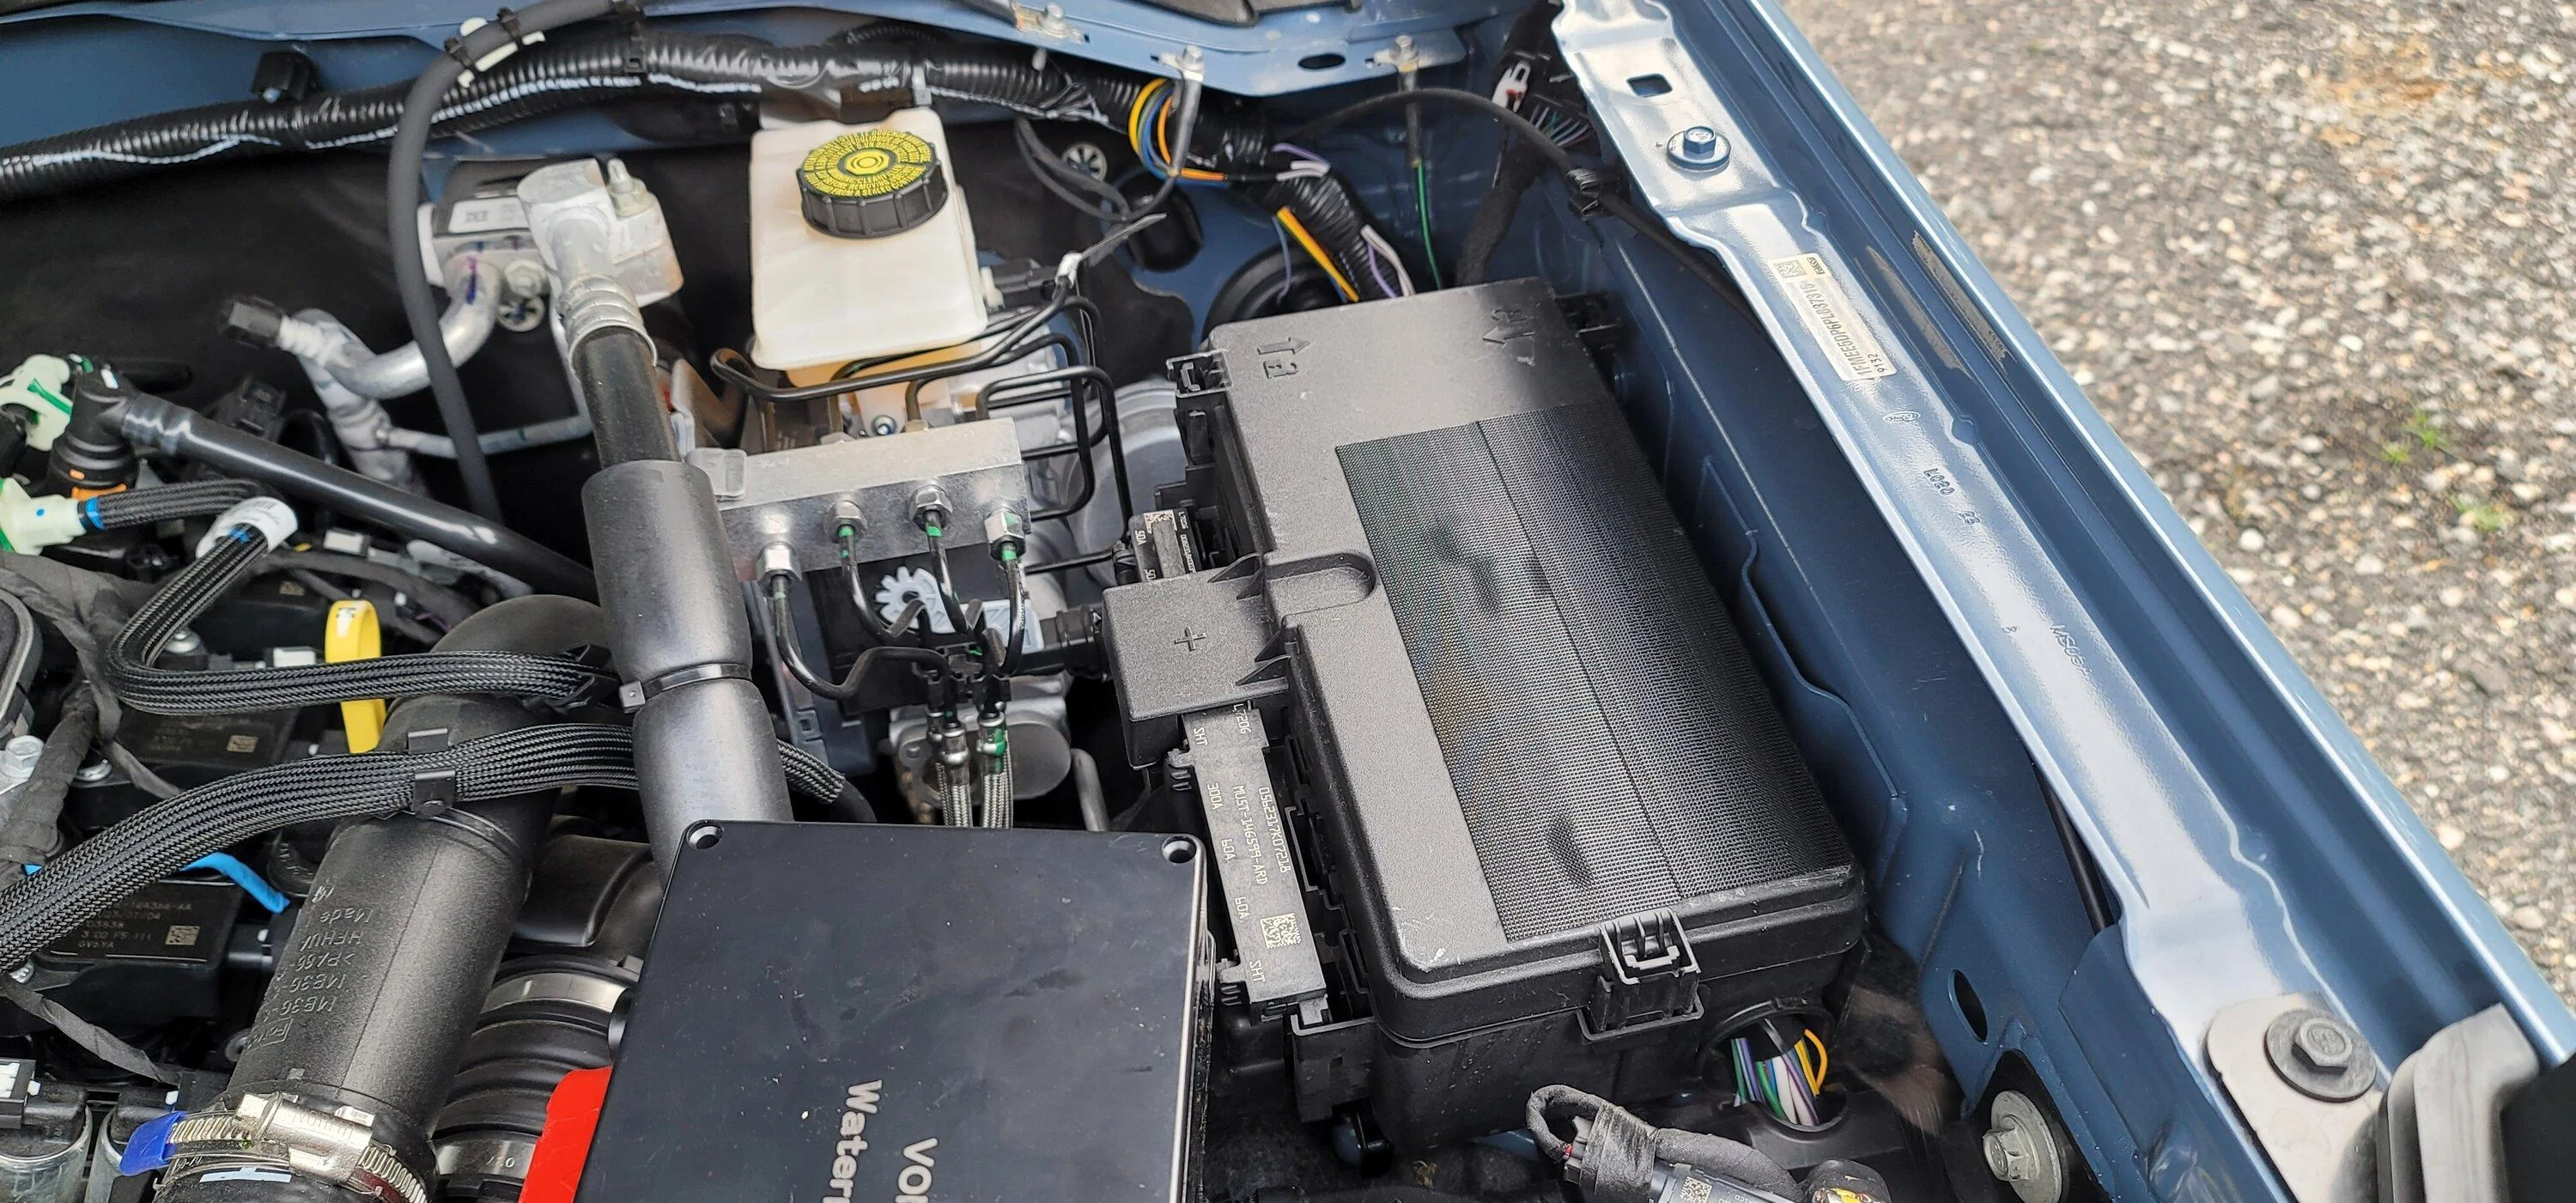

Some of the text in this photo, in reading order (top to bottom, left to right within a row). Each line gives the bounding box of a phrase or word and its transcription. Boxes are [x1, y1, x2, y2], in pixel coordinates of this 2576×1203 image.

[1864, 352, 1887, 374] 9132
[1144, 568, 1157, 582] 50
[1206, 783, 1221, 811] 300A
[1260, 787, 1291, 873] 0562317K07218
